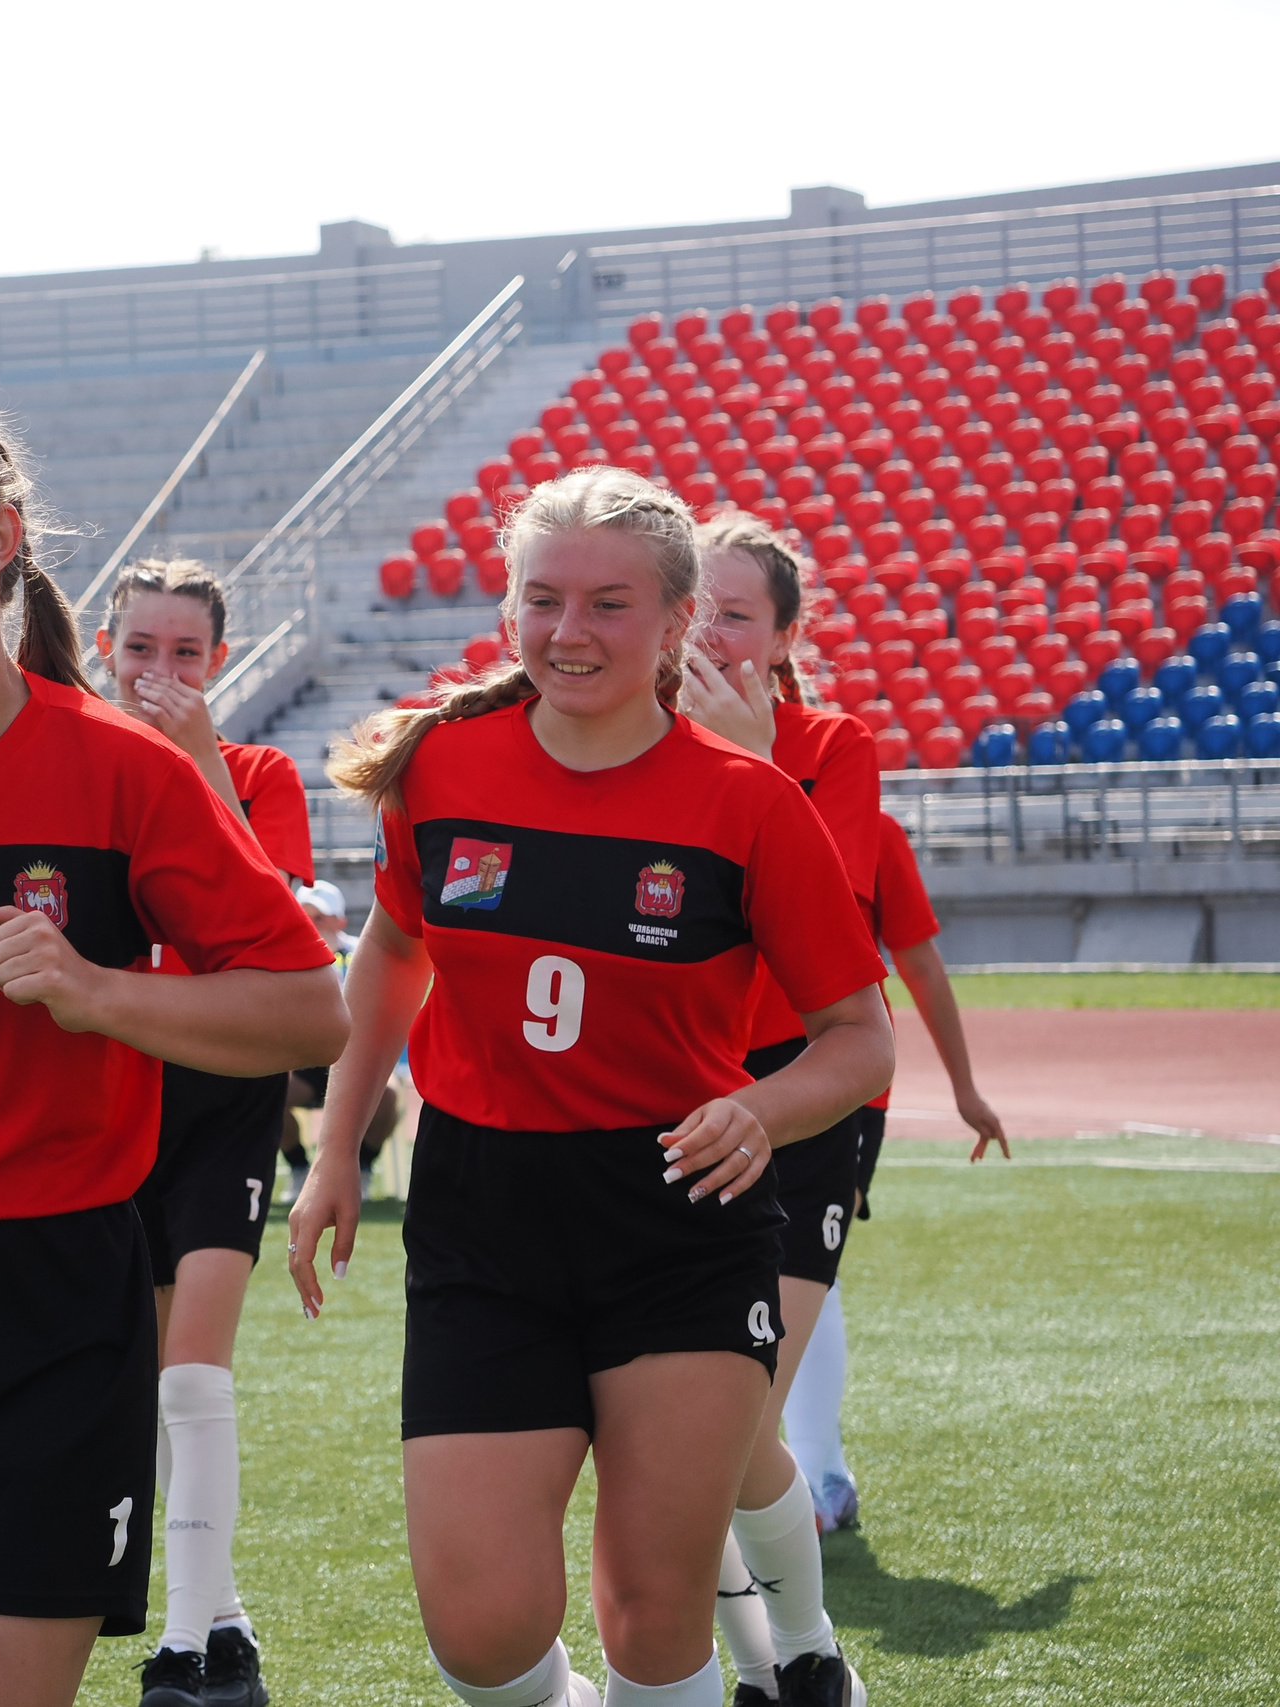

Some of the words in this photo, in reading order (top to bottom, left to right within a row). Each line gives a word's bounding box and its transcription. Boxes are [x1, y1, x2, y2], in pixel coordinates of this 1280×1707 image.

[628, 923, 678, 938] ЧЕЛЯБИНСКАЯ
[636, 934, 668, 946] ОБЛАСТЬ
[522, 955, 585, 1052] 9
[246, 1178, 263, 1222] 7
[822, 1204, 844, 1251] 6
[748, 1301, 776, 1347] 9
[108, 1497, 133, 1566] 1
